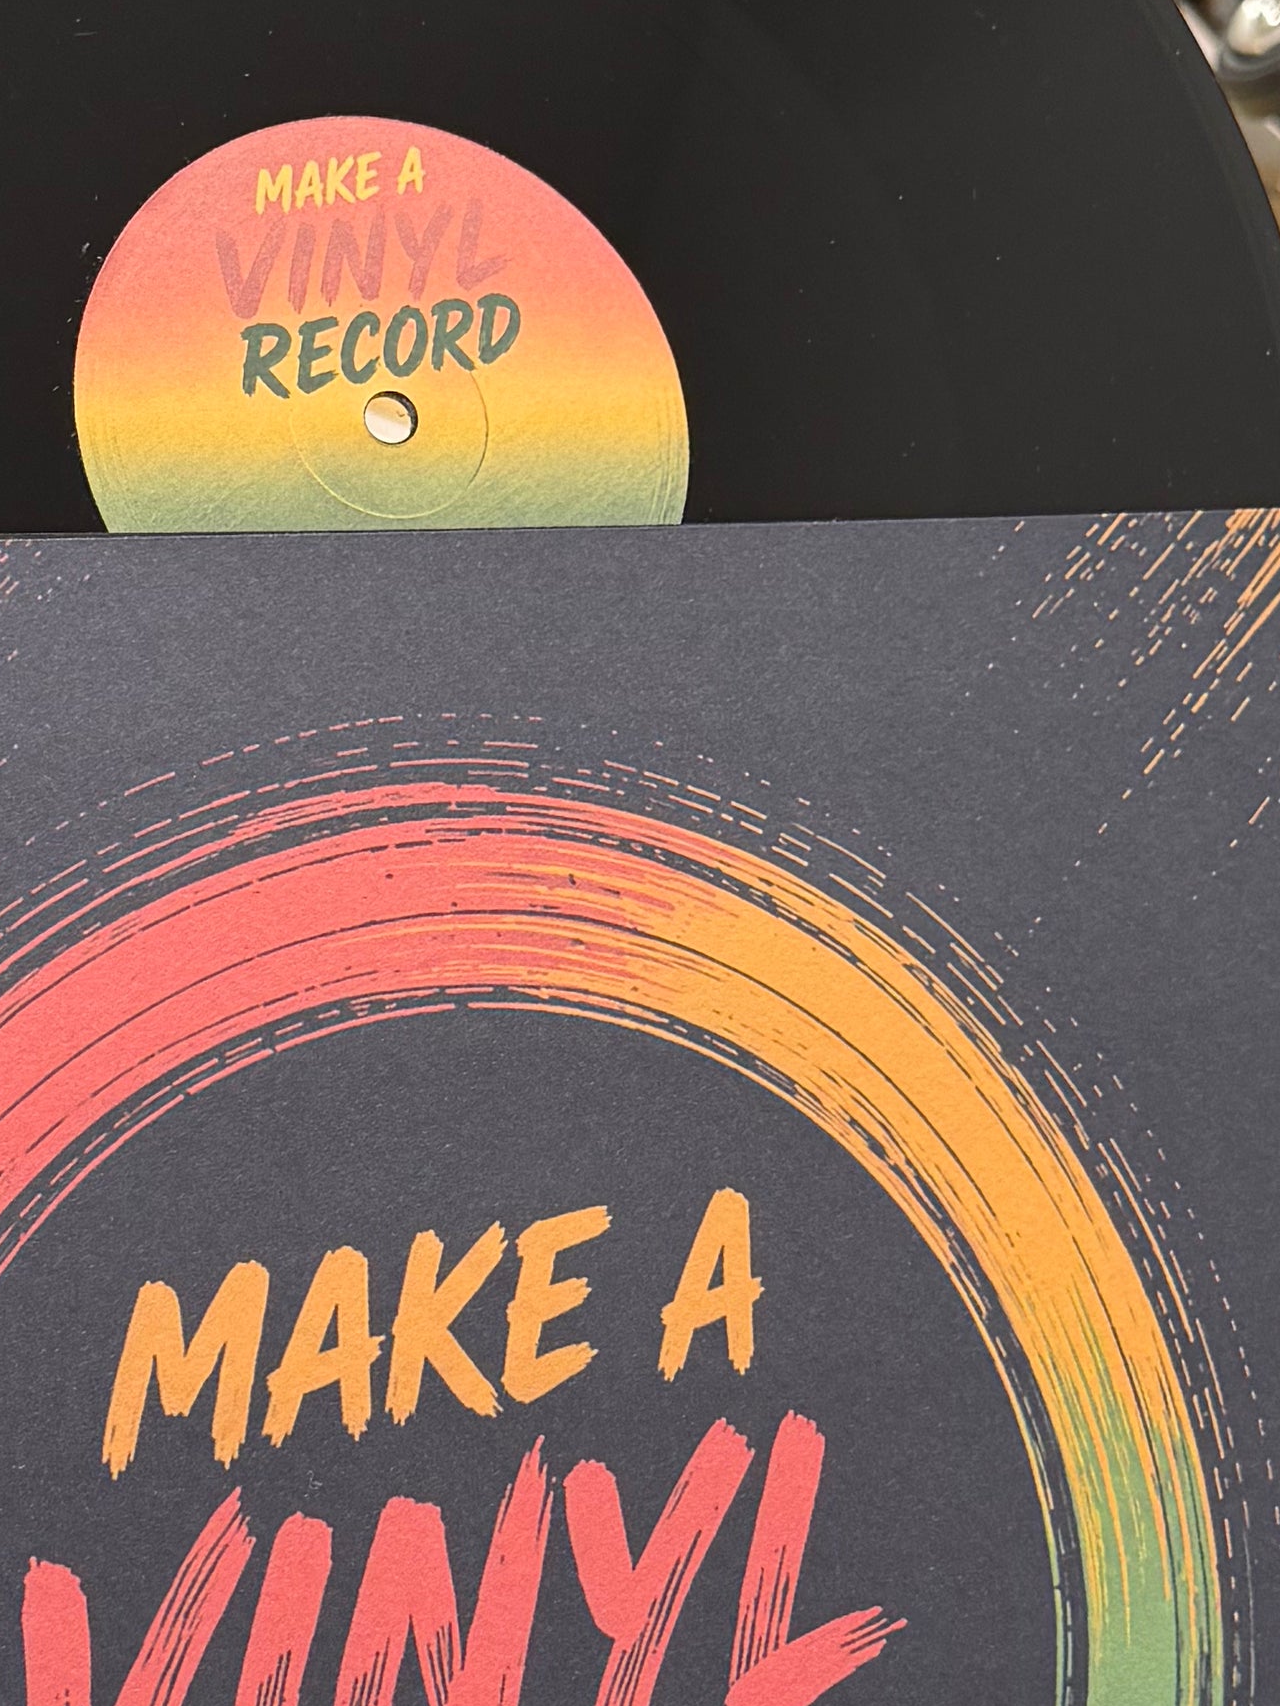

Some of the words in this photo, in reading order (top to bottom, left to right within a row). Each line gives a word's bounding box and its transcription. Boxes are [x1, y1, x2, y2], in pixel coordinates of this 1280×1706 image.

[255, 151, 383, 215] MAKE
[397, 146, 426, 195] A
[215, 198, 516, 320] VINYL
[240, 292, 521, 399] RECORD
[102, 1205, 613, 1480] MAKE
[658, 1187, 766, 1382] A
